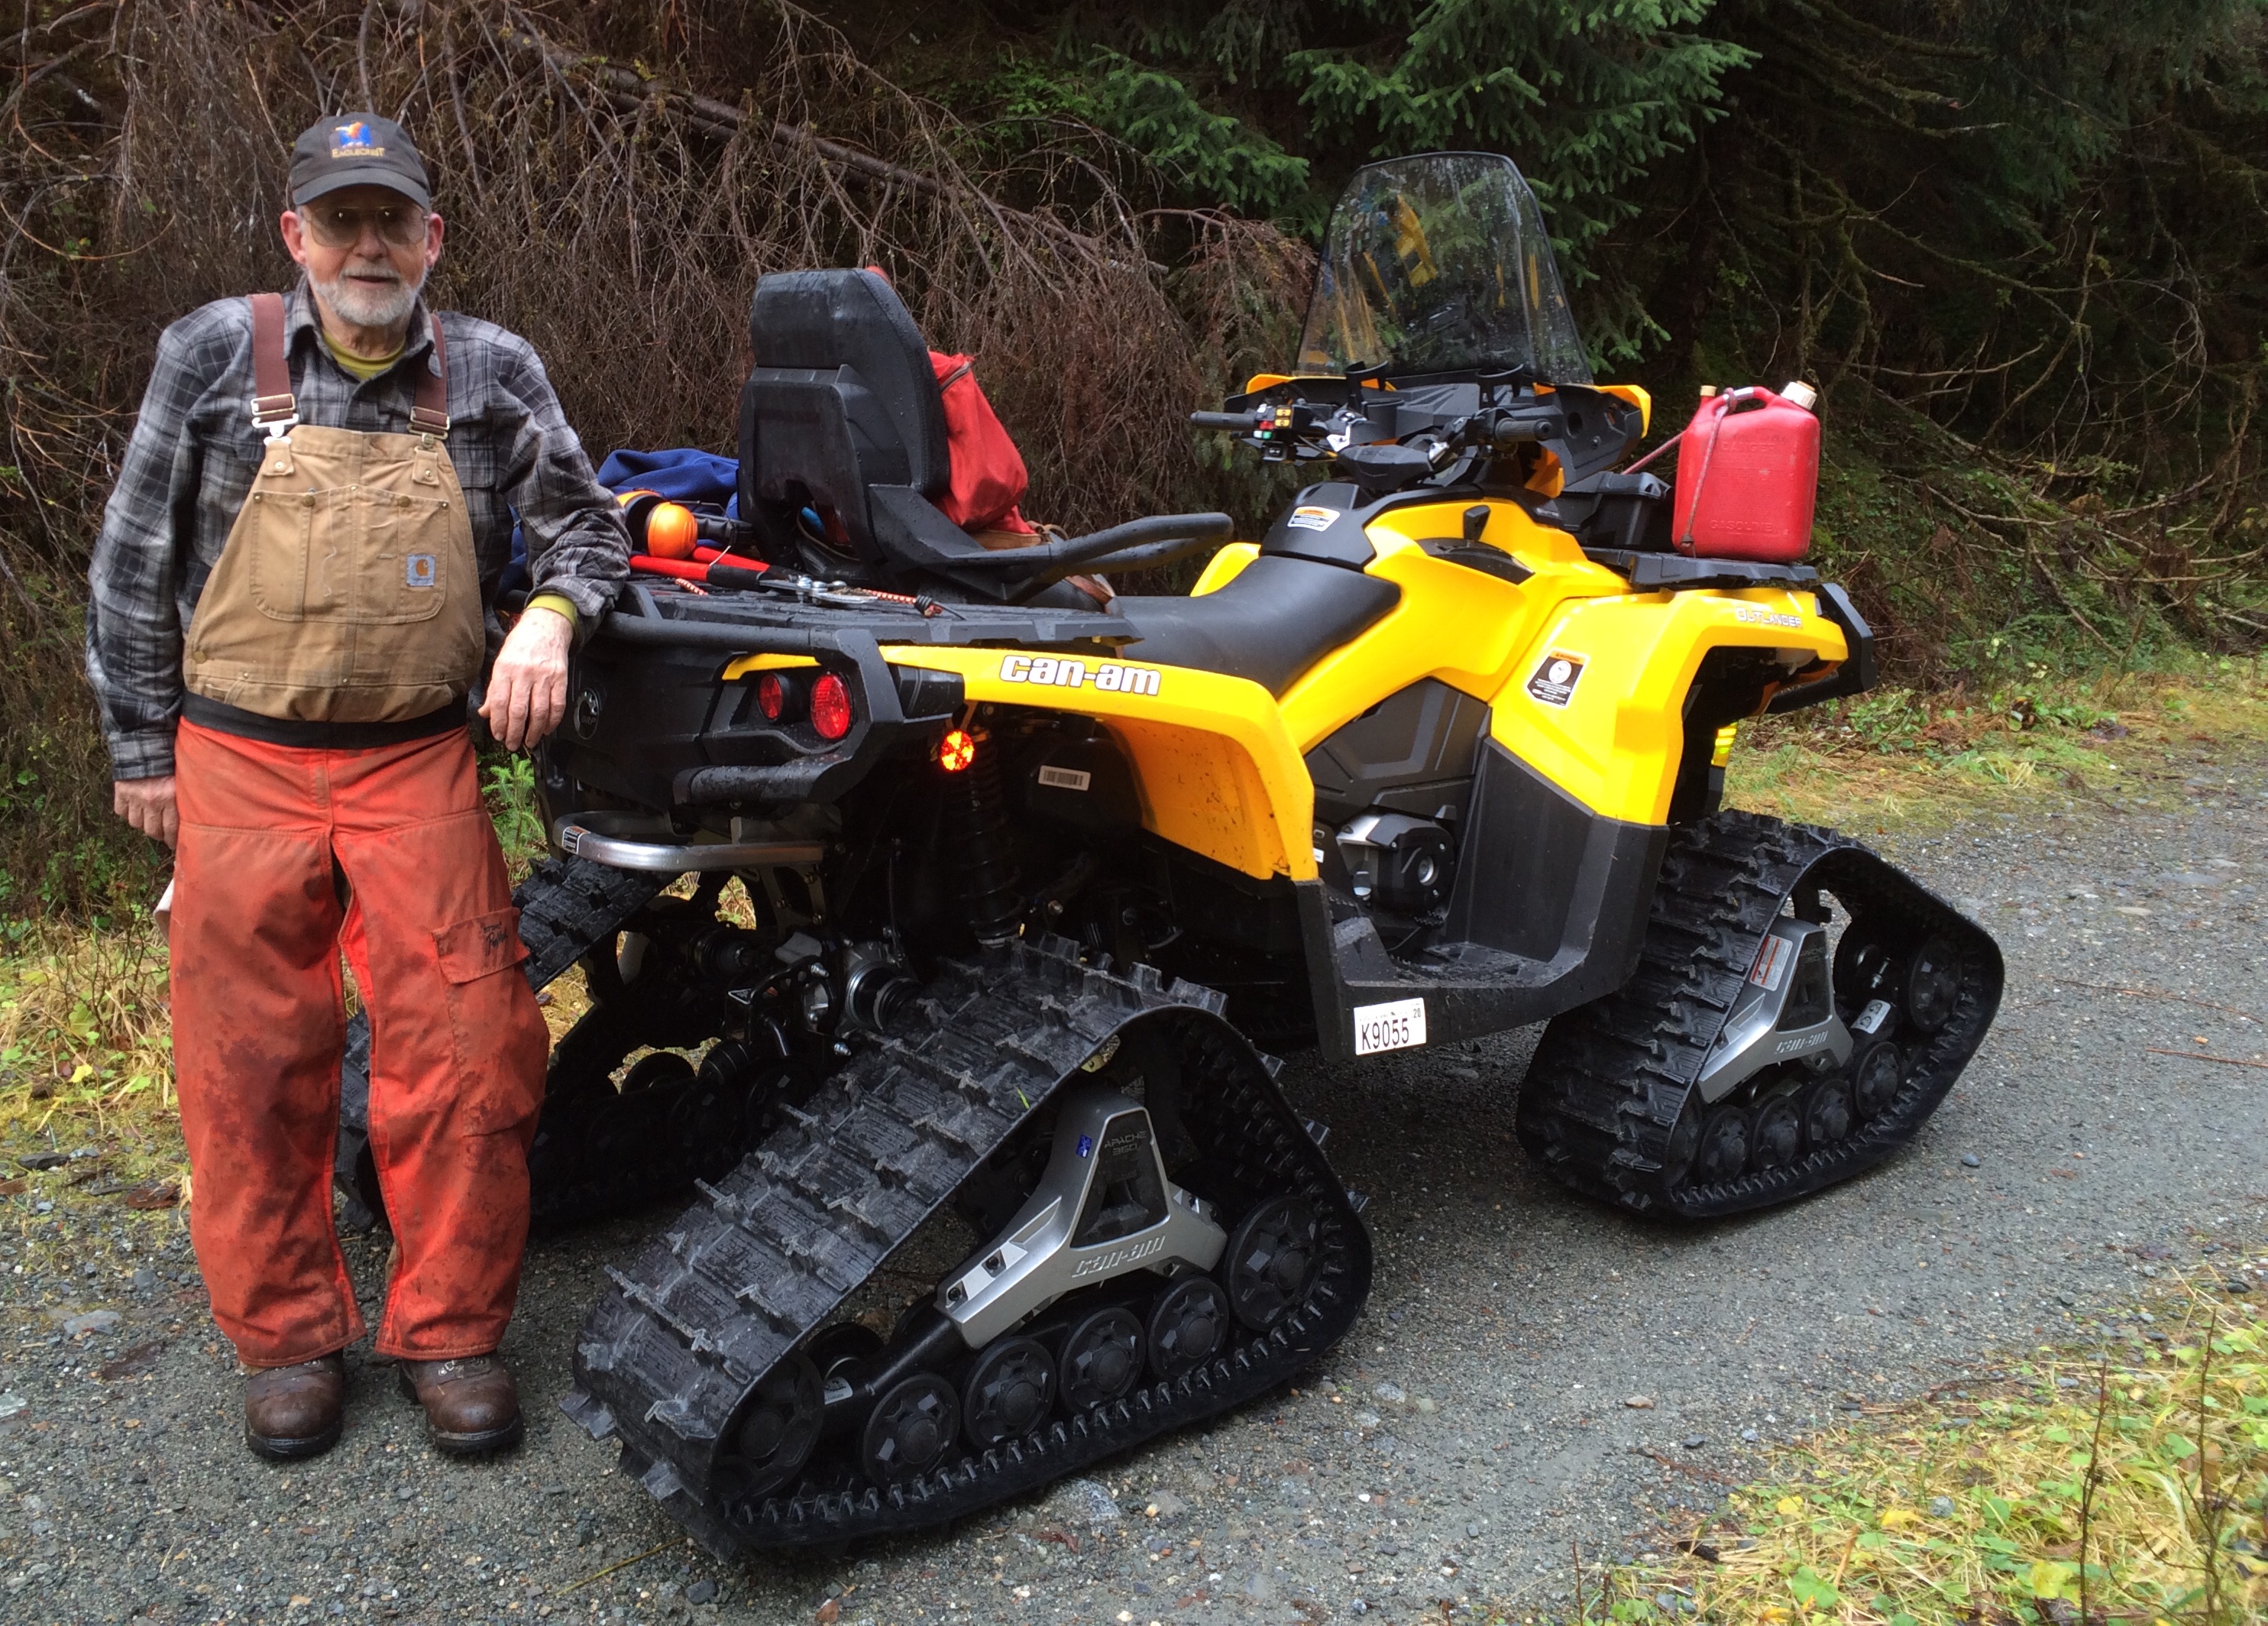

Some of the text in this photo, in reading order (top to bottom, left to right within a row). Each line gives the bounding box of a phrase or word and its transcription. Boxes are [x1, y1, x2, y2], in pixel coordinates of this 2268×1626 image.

[1736, 607, 1803, 630] OUTLANDER
[999, 655, 1161, 696] can-am
[1361, 1017, 1409, 1051] K9055
[1105, 1131, 1147, 1148] APACHE
[1071, 1235, 1166, 1278] can-am
